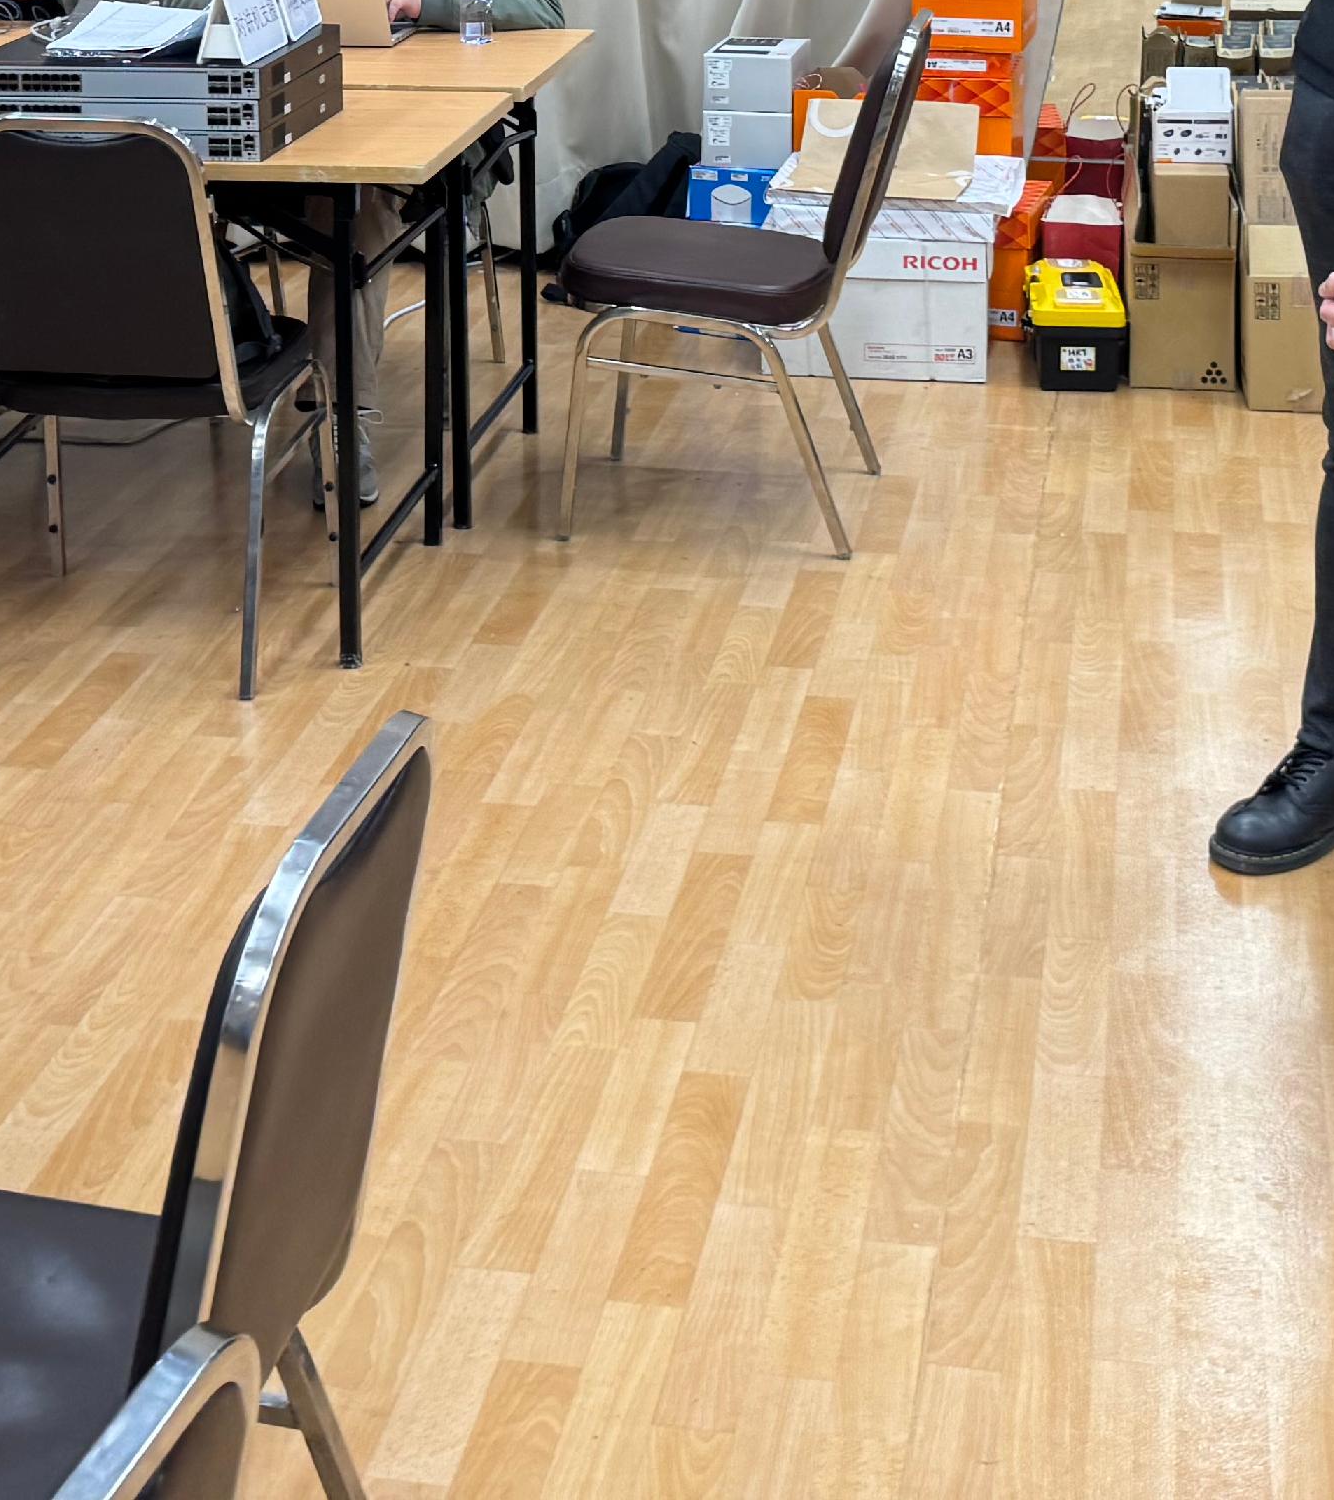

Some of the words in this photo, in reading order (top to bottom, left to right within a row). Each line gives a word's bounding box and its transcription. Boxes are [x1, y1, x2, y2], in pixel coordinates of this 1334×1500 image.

[995, 21, 1010, 33] A4
[903, 255, 978, 271] RICOH
[999, 312, 1015, 323] A4
[957, 349, 973, 360] A3
